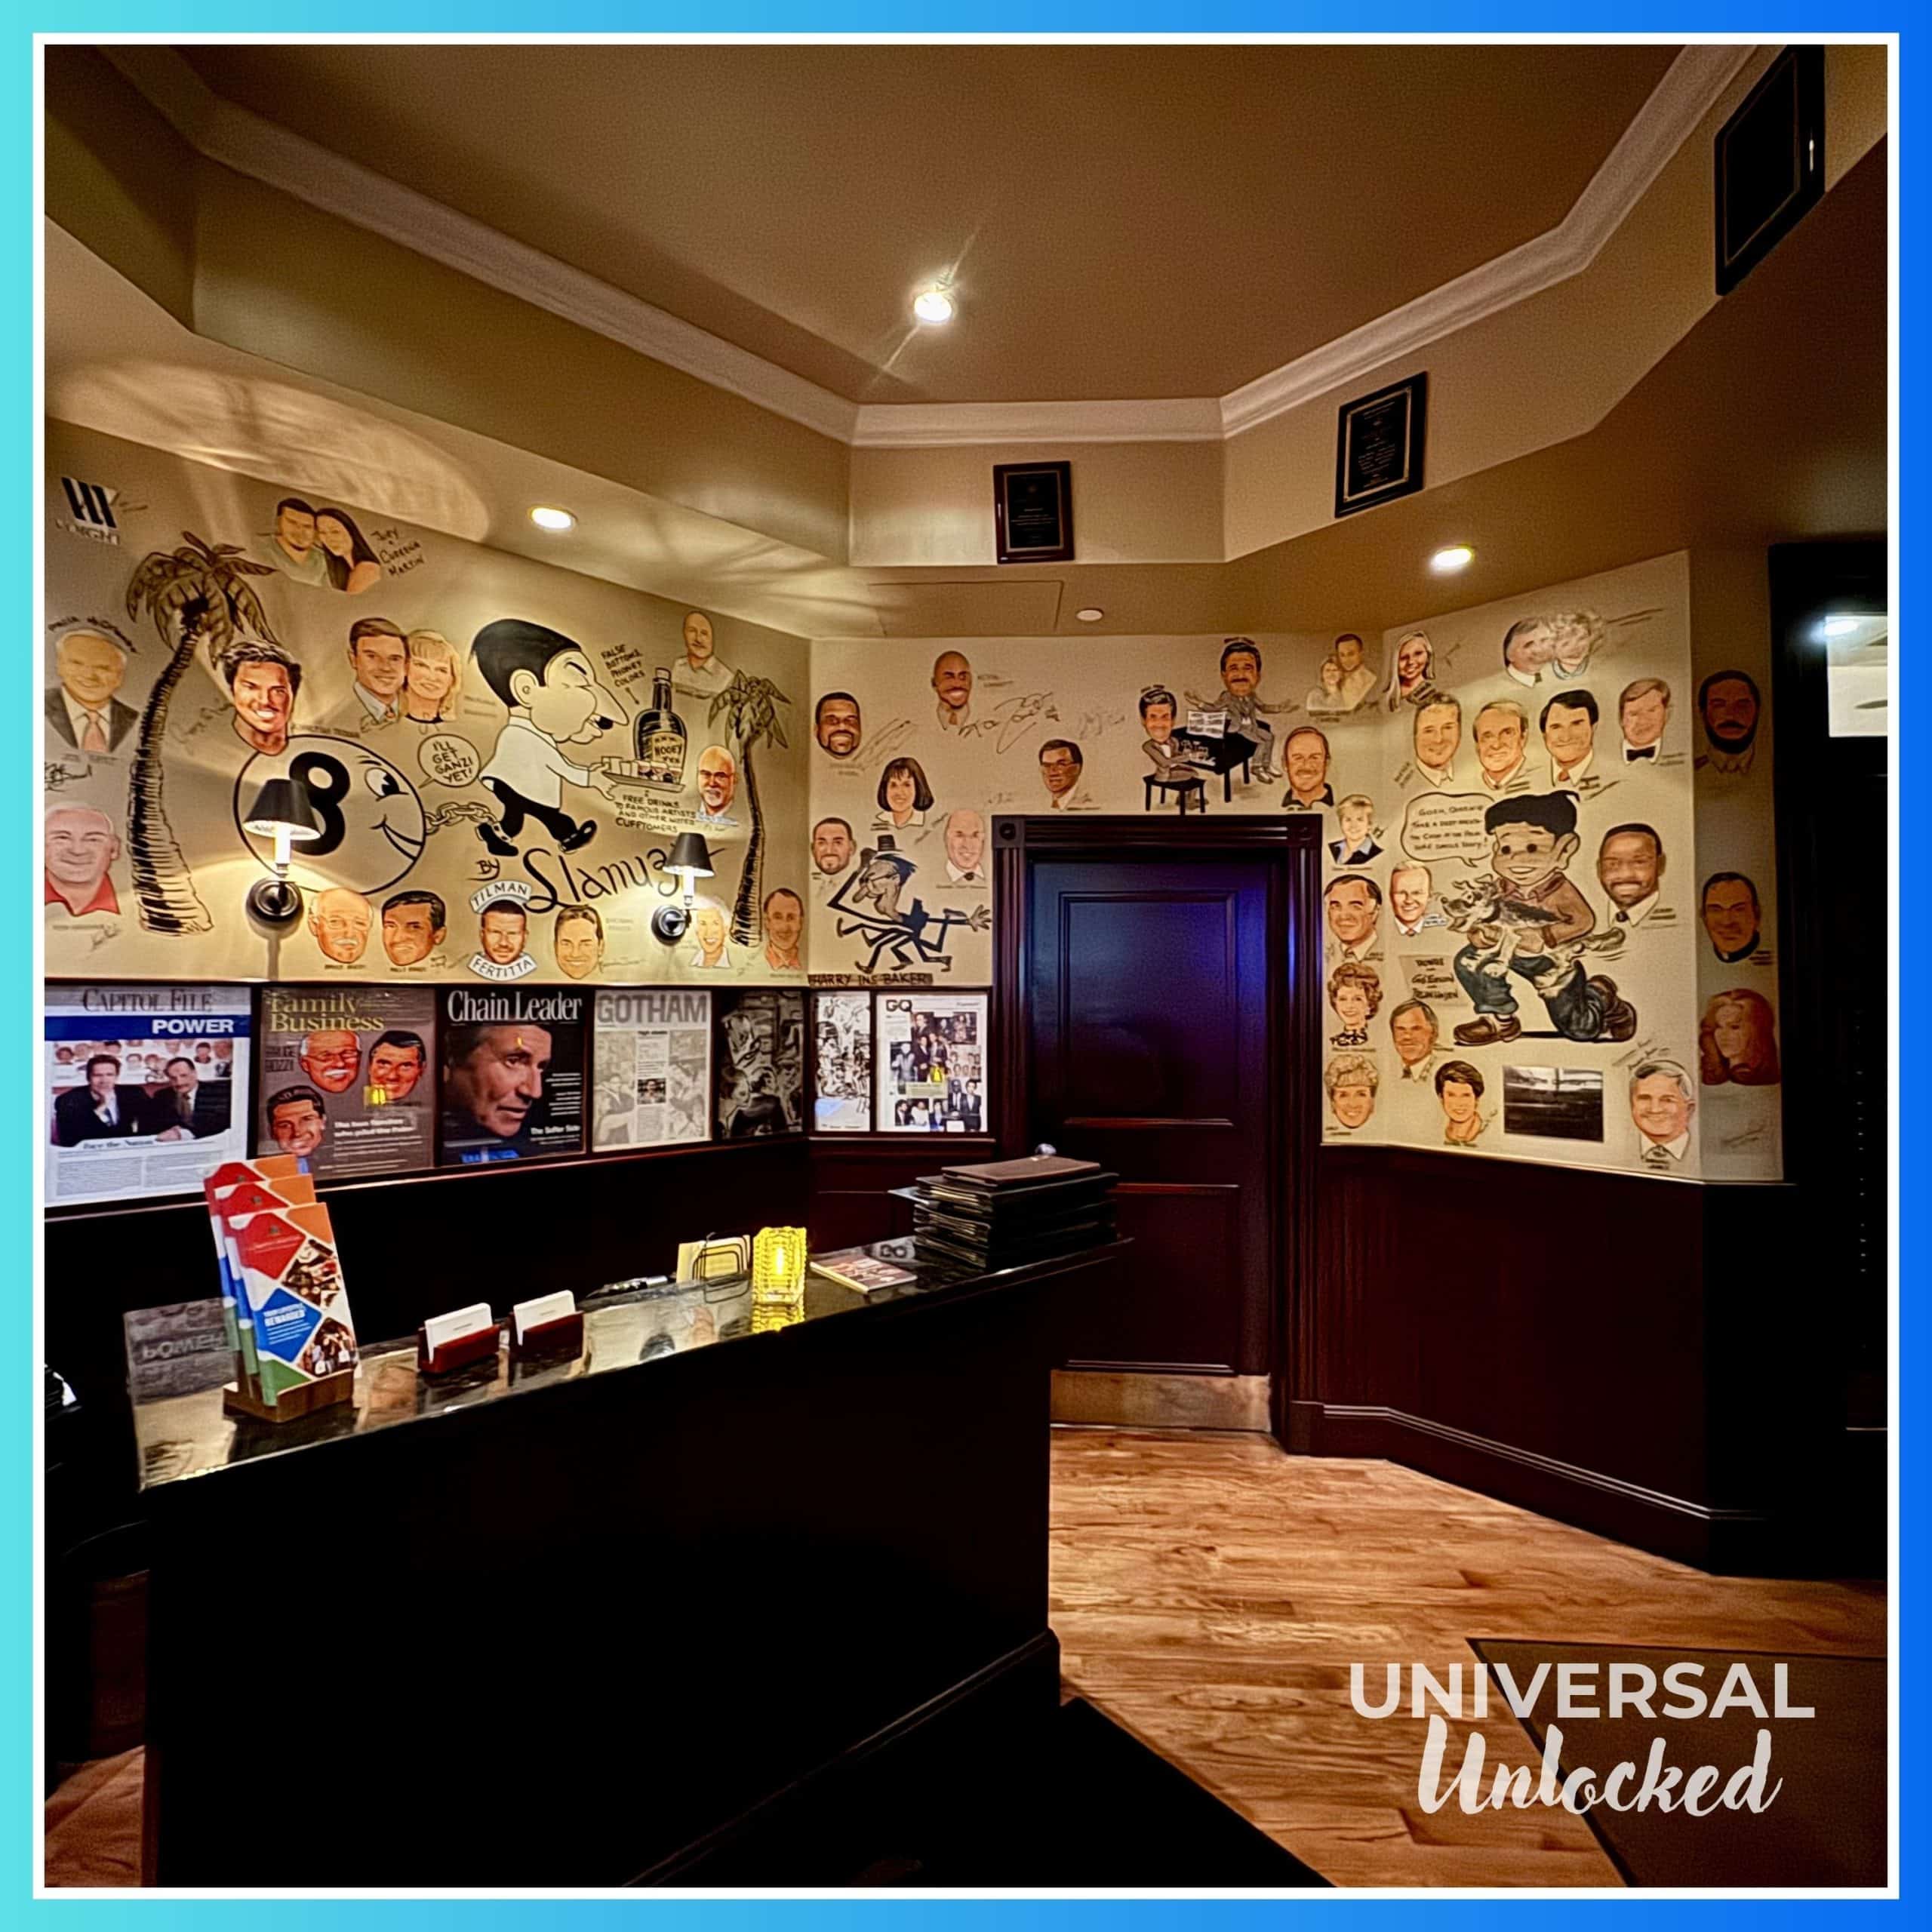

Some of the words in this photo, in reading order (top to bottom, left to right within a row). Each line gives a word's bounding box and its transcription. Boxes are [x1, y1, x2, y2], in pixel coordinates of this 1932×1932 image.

[432, 749, 458, 764] GET
[289, 752, 351, 856] 8
[623, 795, 644, 803] FREE
[648, 798, 679, 808] DRINKS
[473, 884, 528, 906] TILMAN
[472, 957, 532, 977] FERTITTA
[82, 988, 165, 1012] CAPITOL
[171, 988, 213, 1012] FILE
[271, 992, 358, 1016] Family
[448, 990, 515, 1023] Chain
[515, 990, 583, 1022] Leader
[596, 995, 707, 1023] GOTHAM
[885, 999, 913, 1014] GQ
[152, 1020, 234, 1035] POWER
[271, 1013, 385, 1032] Business
